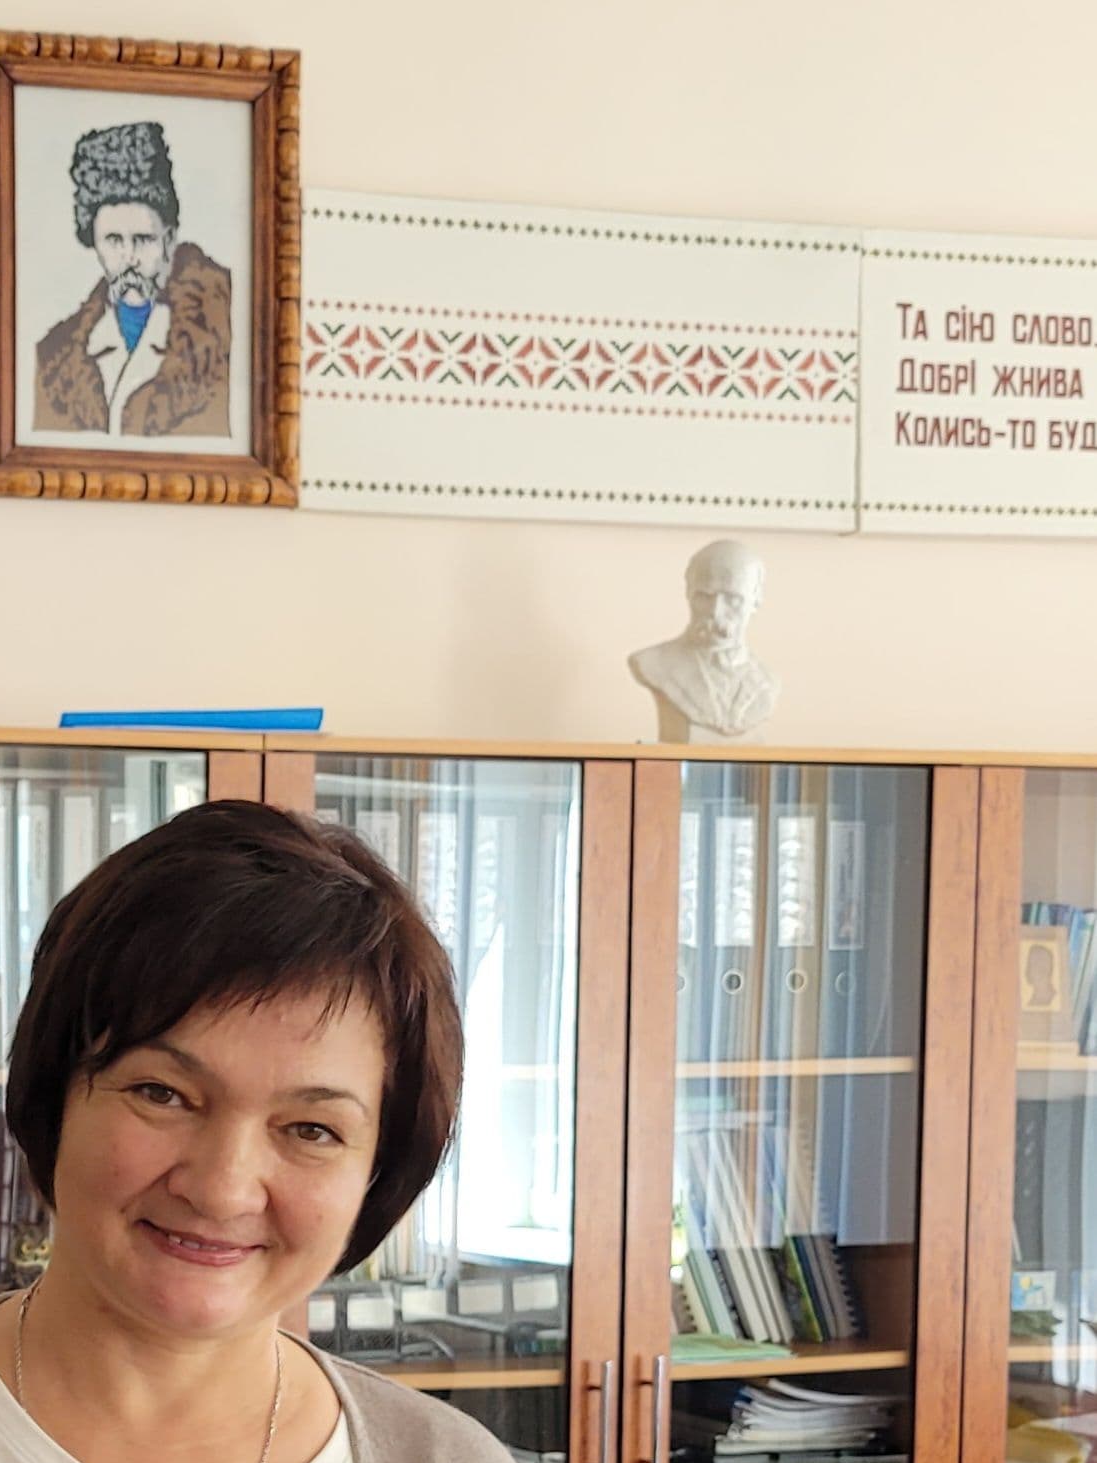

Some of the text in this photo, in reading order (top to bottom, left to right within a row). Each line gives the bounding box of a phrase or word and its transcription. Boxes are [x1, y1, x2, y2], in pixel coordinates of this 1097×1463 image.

[895, 357, 1084, 399] ДОБРІ ЖНИВА
[895, 411, 1036, 450] КОЛИСЬ-ТО
